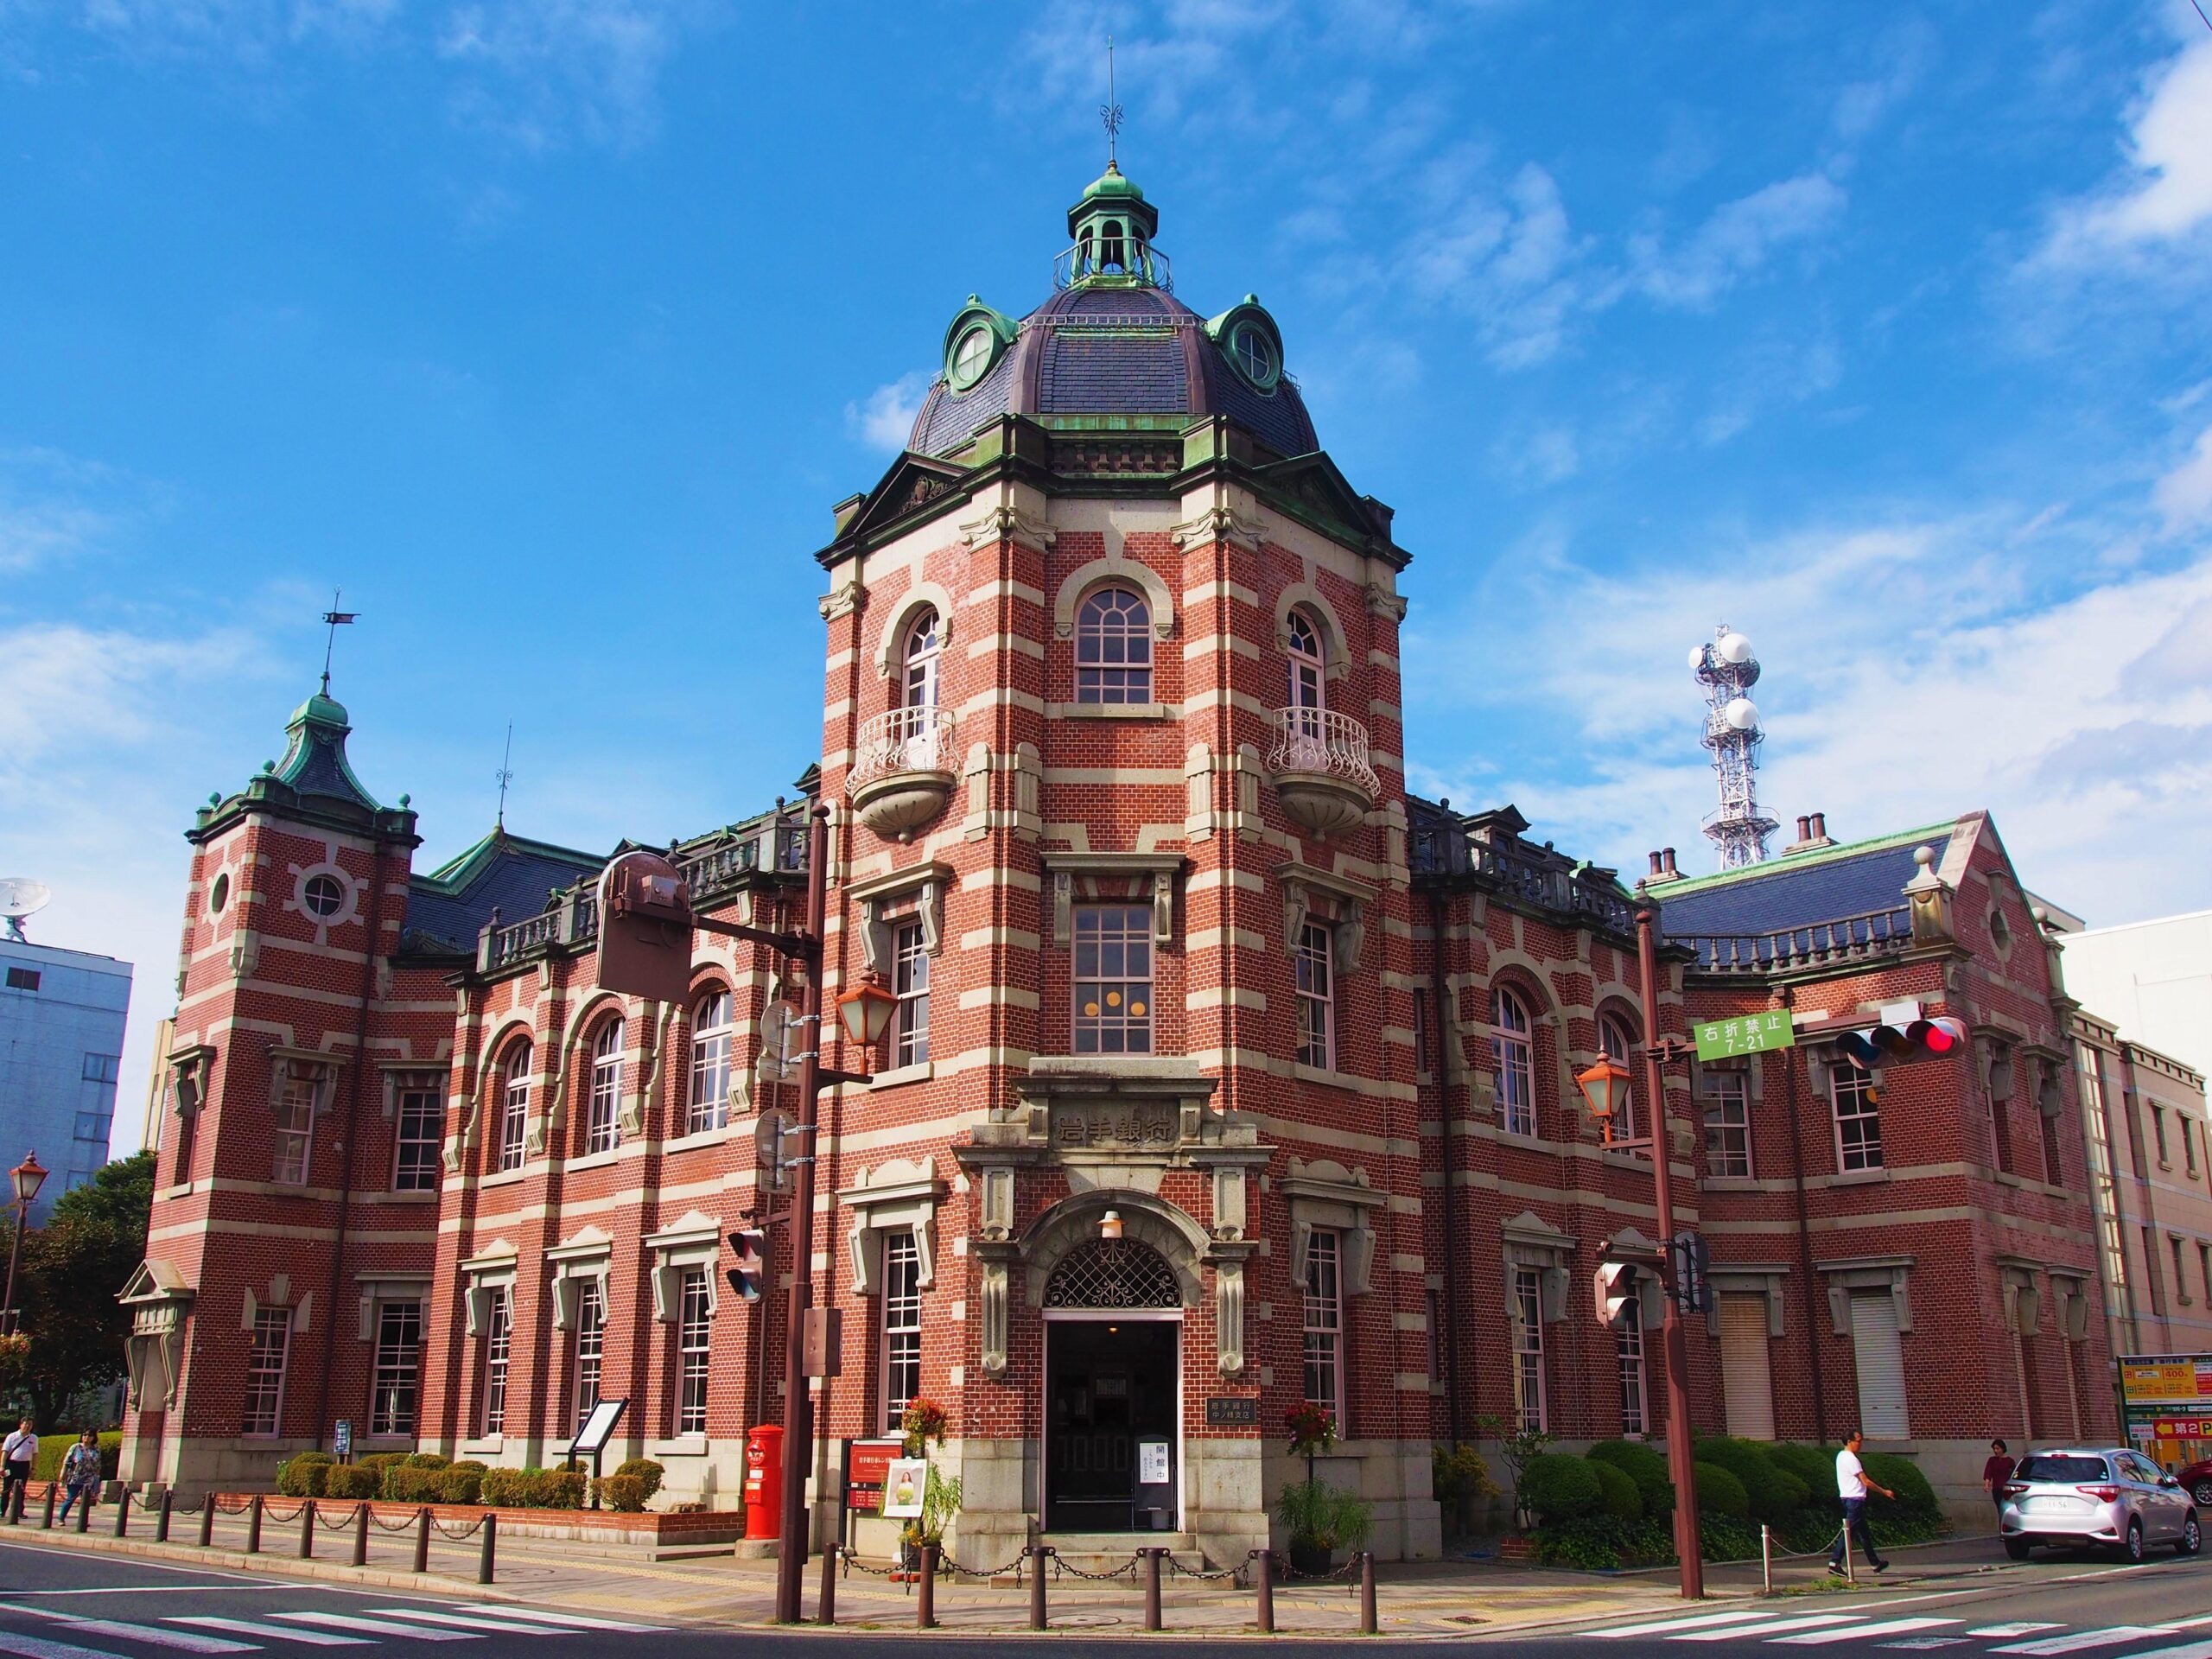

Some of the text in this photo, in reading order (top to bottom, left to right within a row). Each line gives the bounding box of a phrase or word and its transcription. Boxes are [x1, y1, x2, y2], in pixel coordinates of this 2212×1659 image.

[1704, 1015, 1781, 1041] 右折禁止
[1725, 1034, 1764, 1053] 7-21
[1058, 1117, 1172, 1141] 岩手銀行
[1211, 1402, 1251, 1410] 岩手銀行
[1156, 1446, 1165, 1479] 開館中
